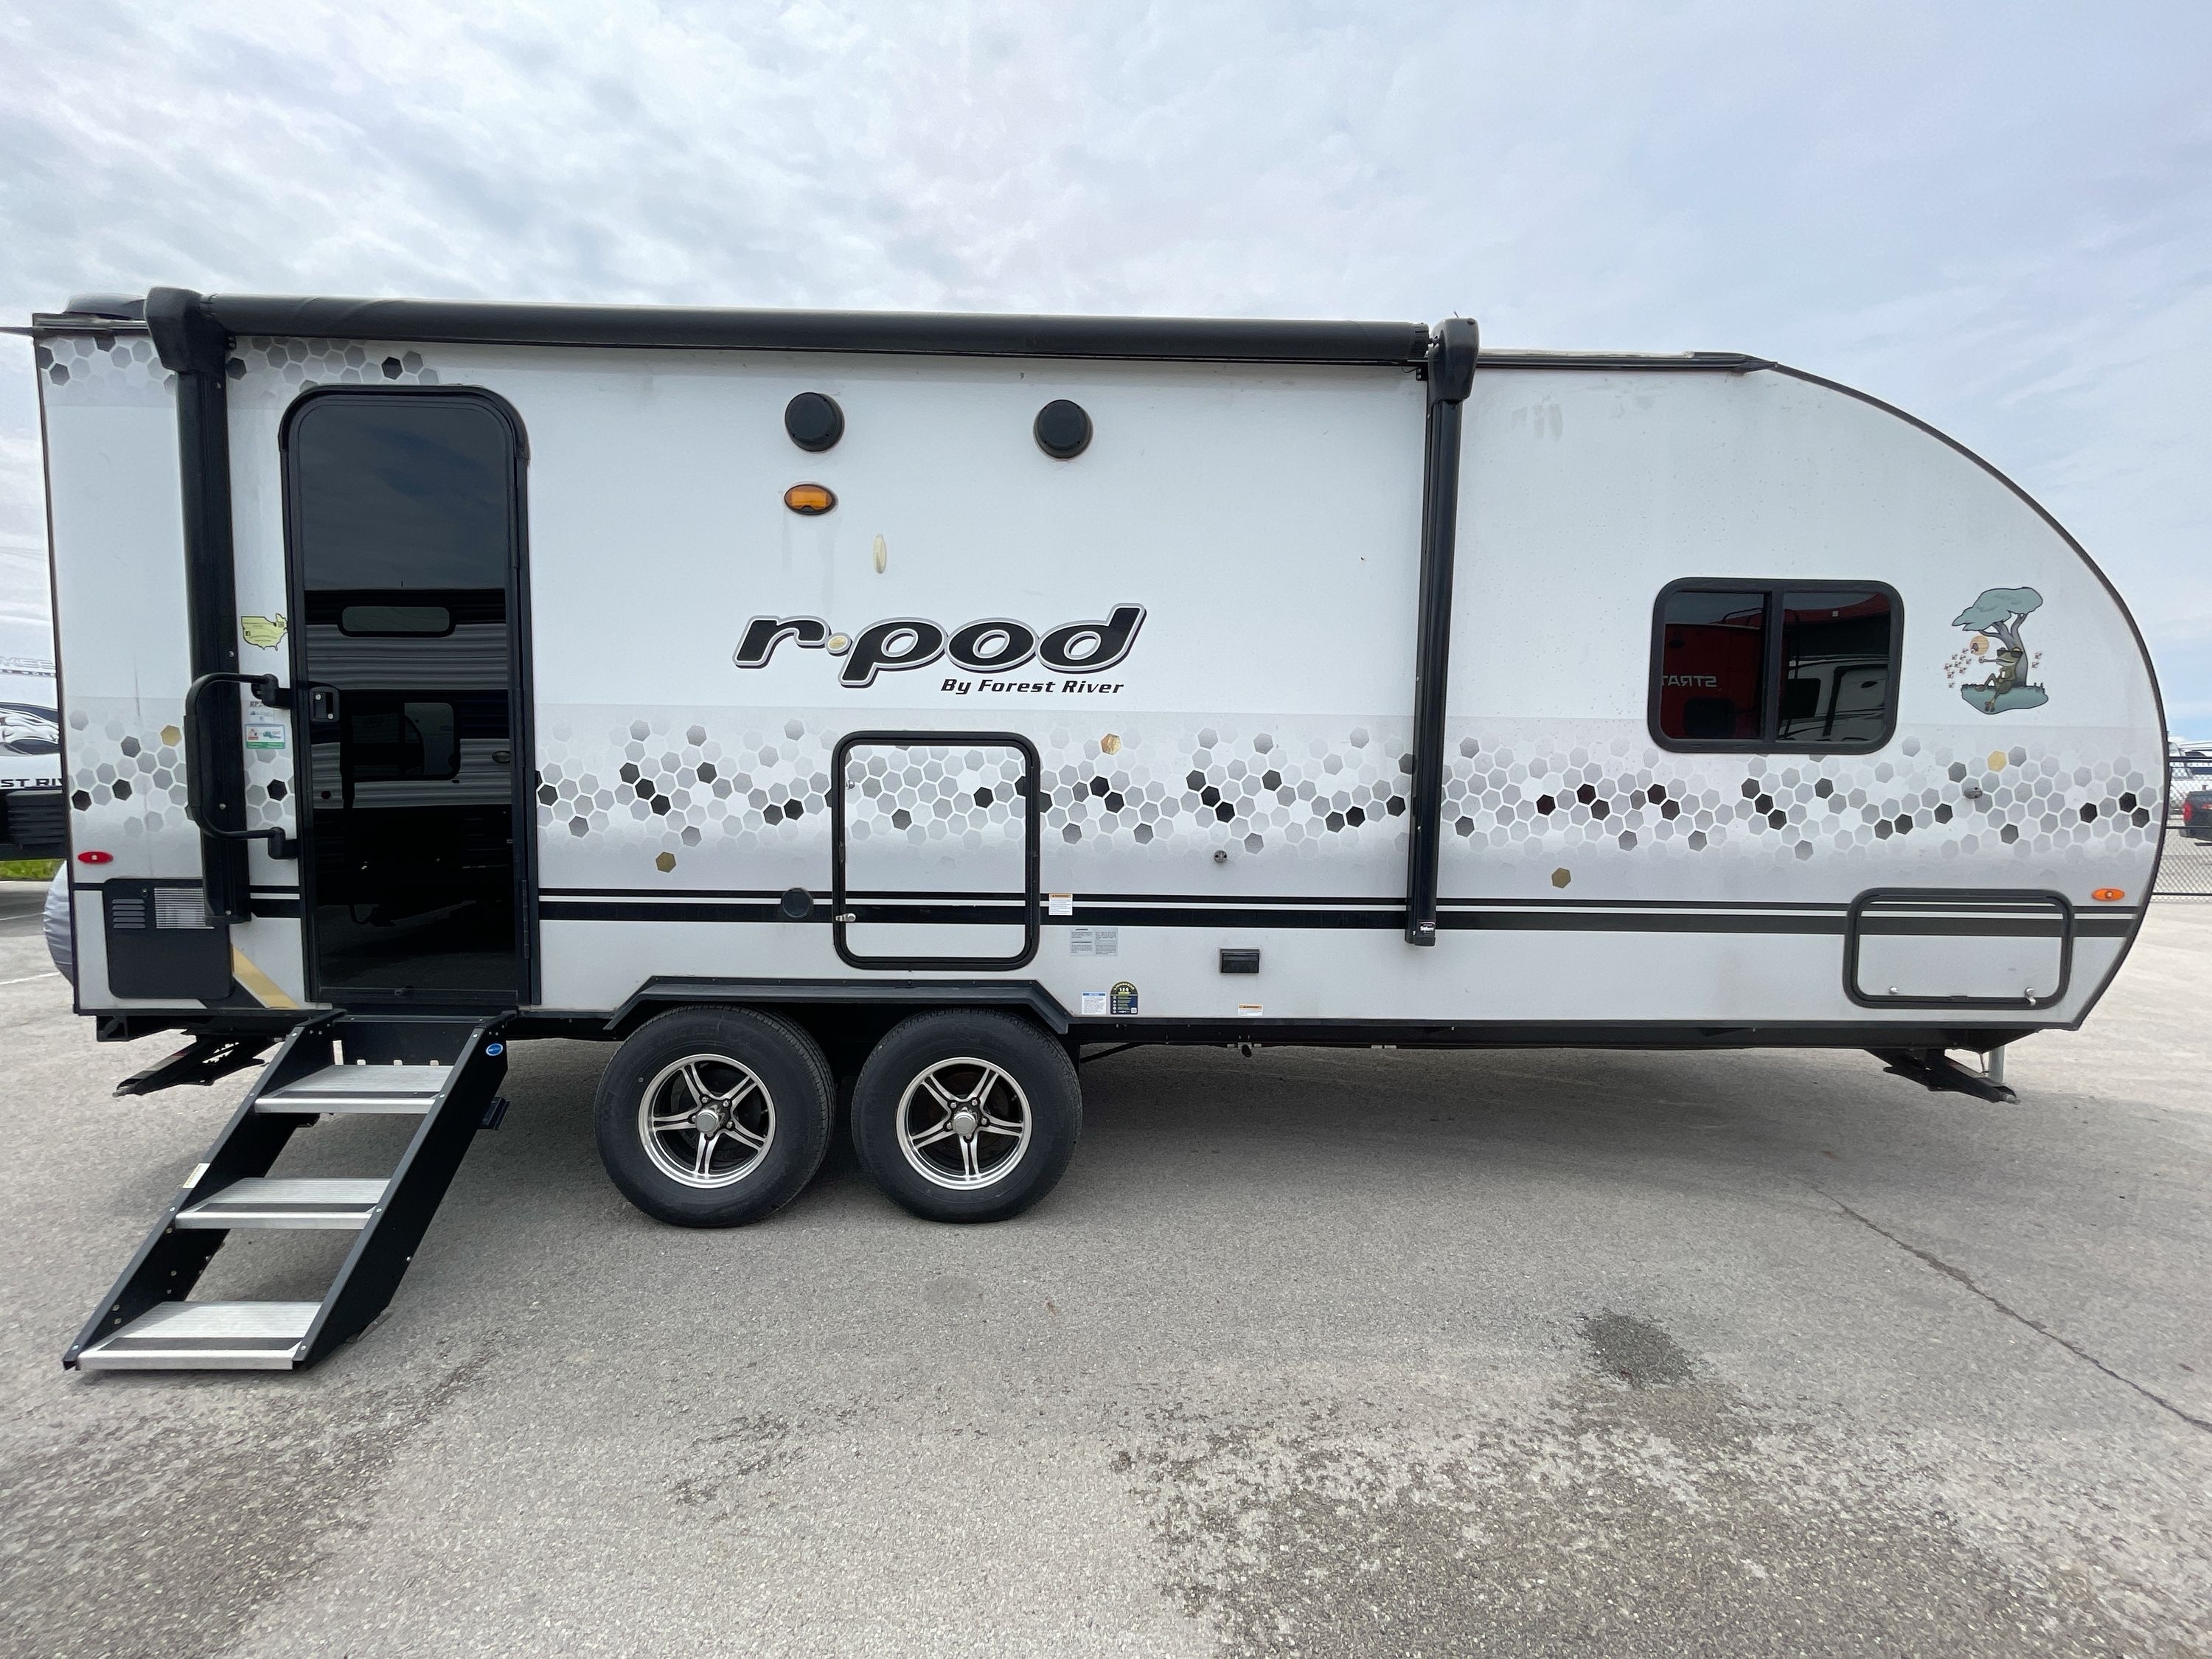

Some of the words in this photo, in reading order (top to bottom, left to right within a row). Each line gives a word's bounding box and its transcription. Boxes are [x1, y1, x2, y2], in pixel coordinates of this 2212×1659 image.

[940, 678, 972, 695] By
[978, 679, 1056, 693] Forest
[1061, 680, 1124, 694] River
